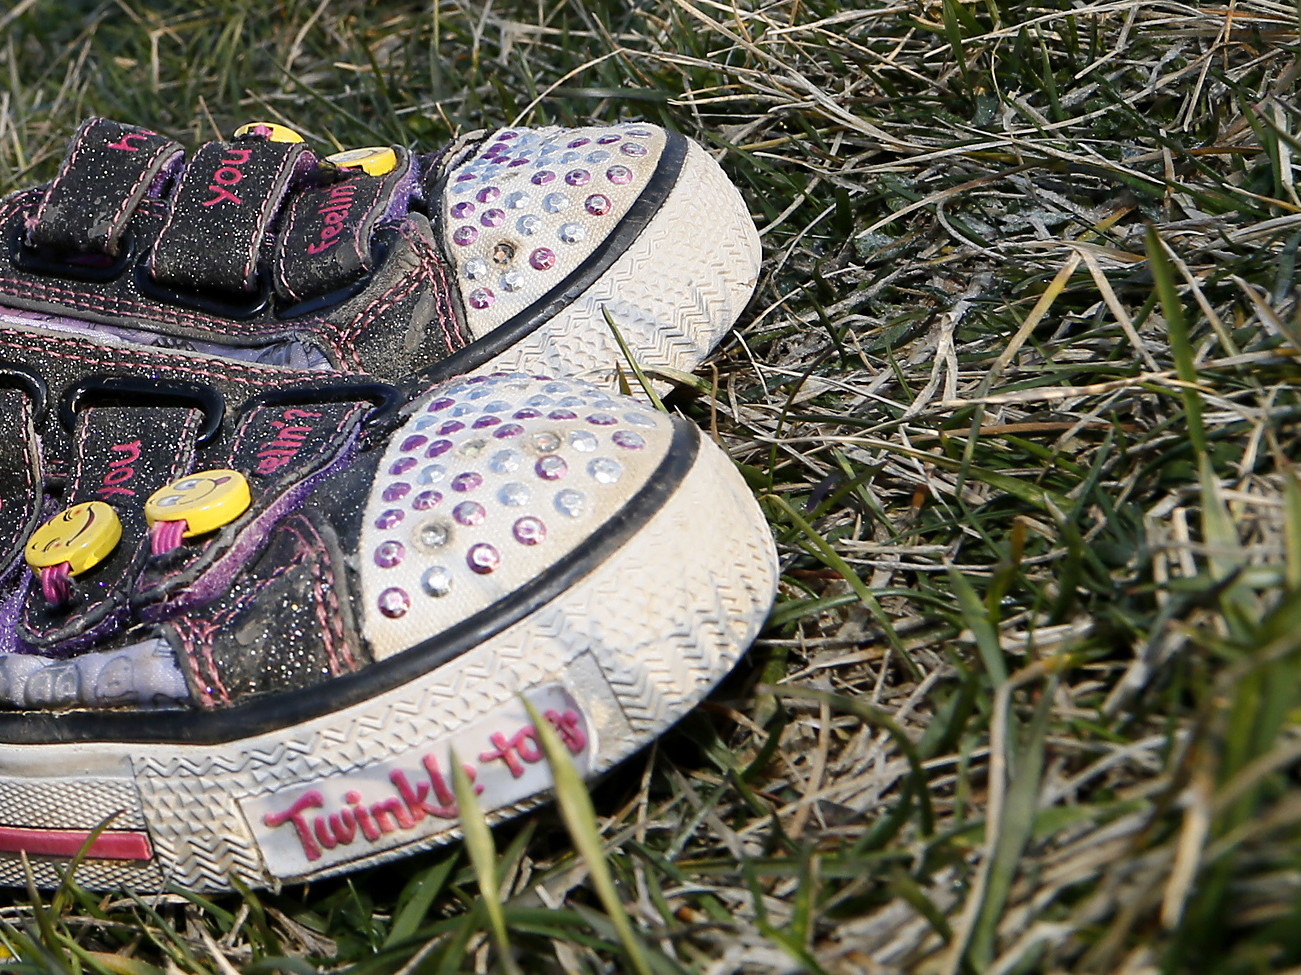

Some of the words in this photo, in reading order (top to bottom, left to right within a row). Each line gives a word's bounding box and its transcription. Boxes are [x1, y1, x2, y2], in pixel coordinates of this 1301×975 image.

[203, 148, 253, 207] you
[97, 439, 140, 497] you
[479, 709, 587, 778] tos
